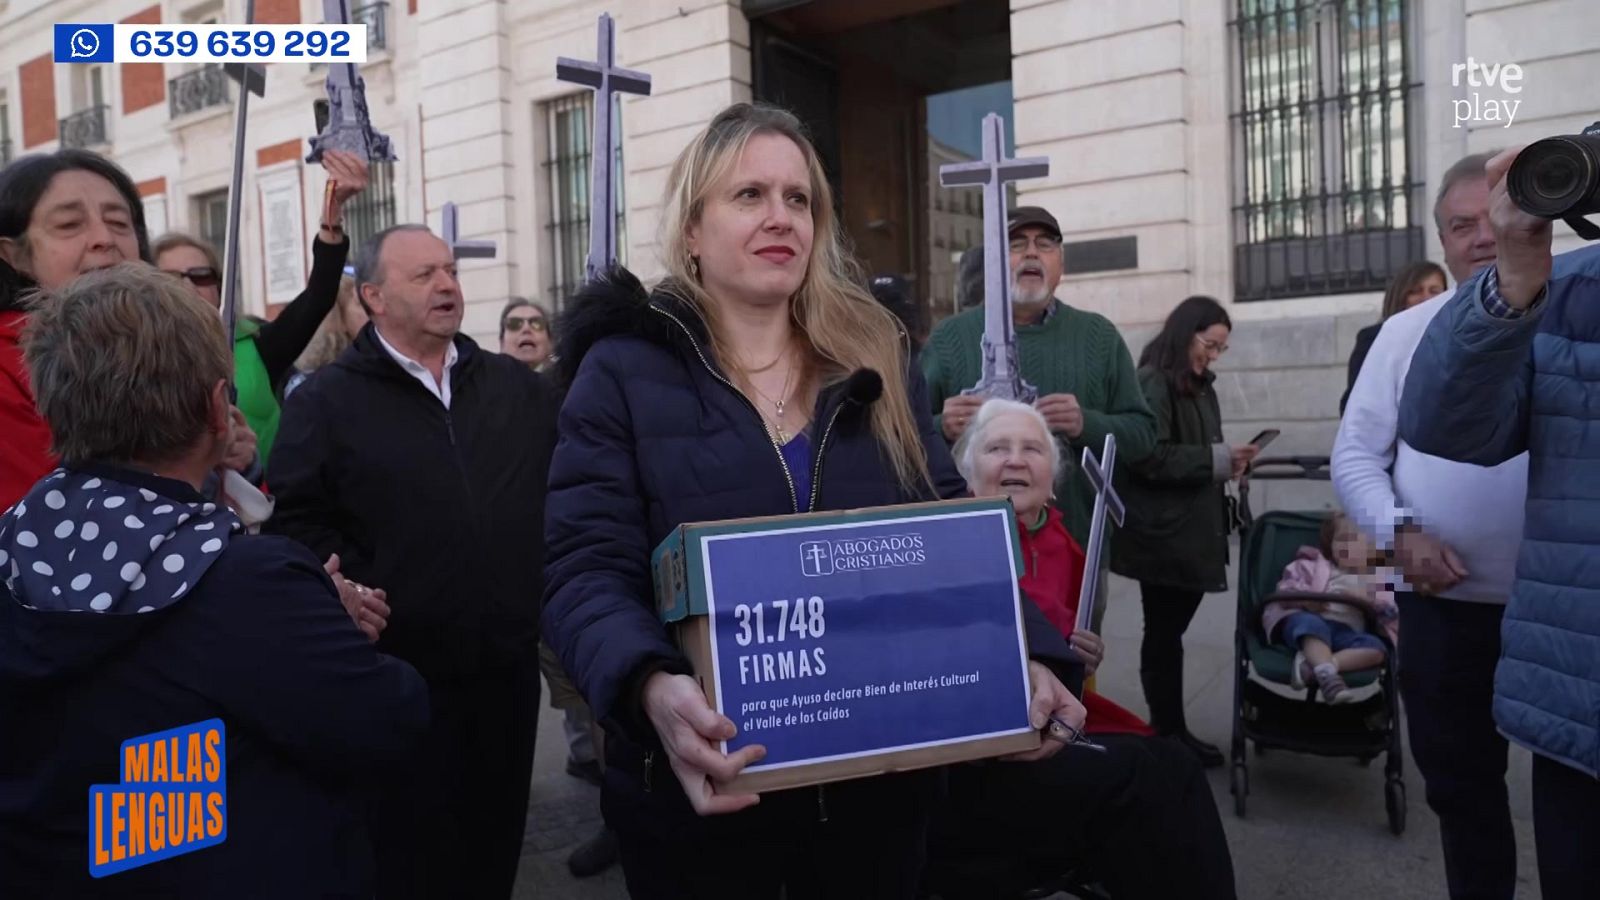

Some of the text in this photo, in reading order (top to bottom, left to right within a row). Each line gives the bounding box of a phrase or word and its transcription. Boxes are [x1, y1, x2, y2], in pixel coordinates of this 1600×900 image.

[834, 535, 924, 556] ABOGADOS
[835, 549, 926, 570] CRISTIANOS
[734, 595, 826, 647] 31.748
[739, 647, 827, 685] FIRMAS
[742, 670, 980, 716] para que Ayuso declare Bien de Interés Cultural
[743, 706, 850, 732] el Valle de los Caídos
